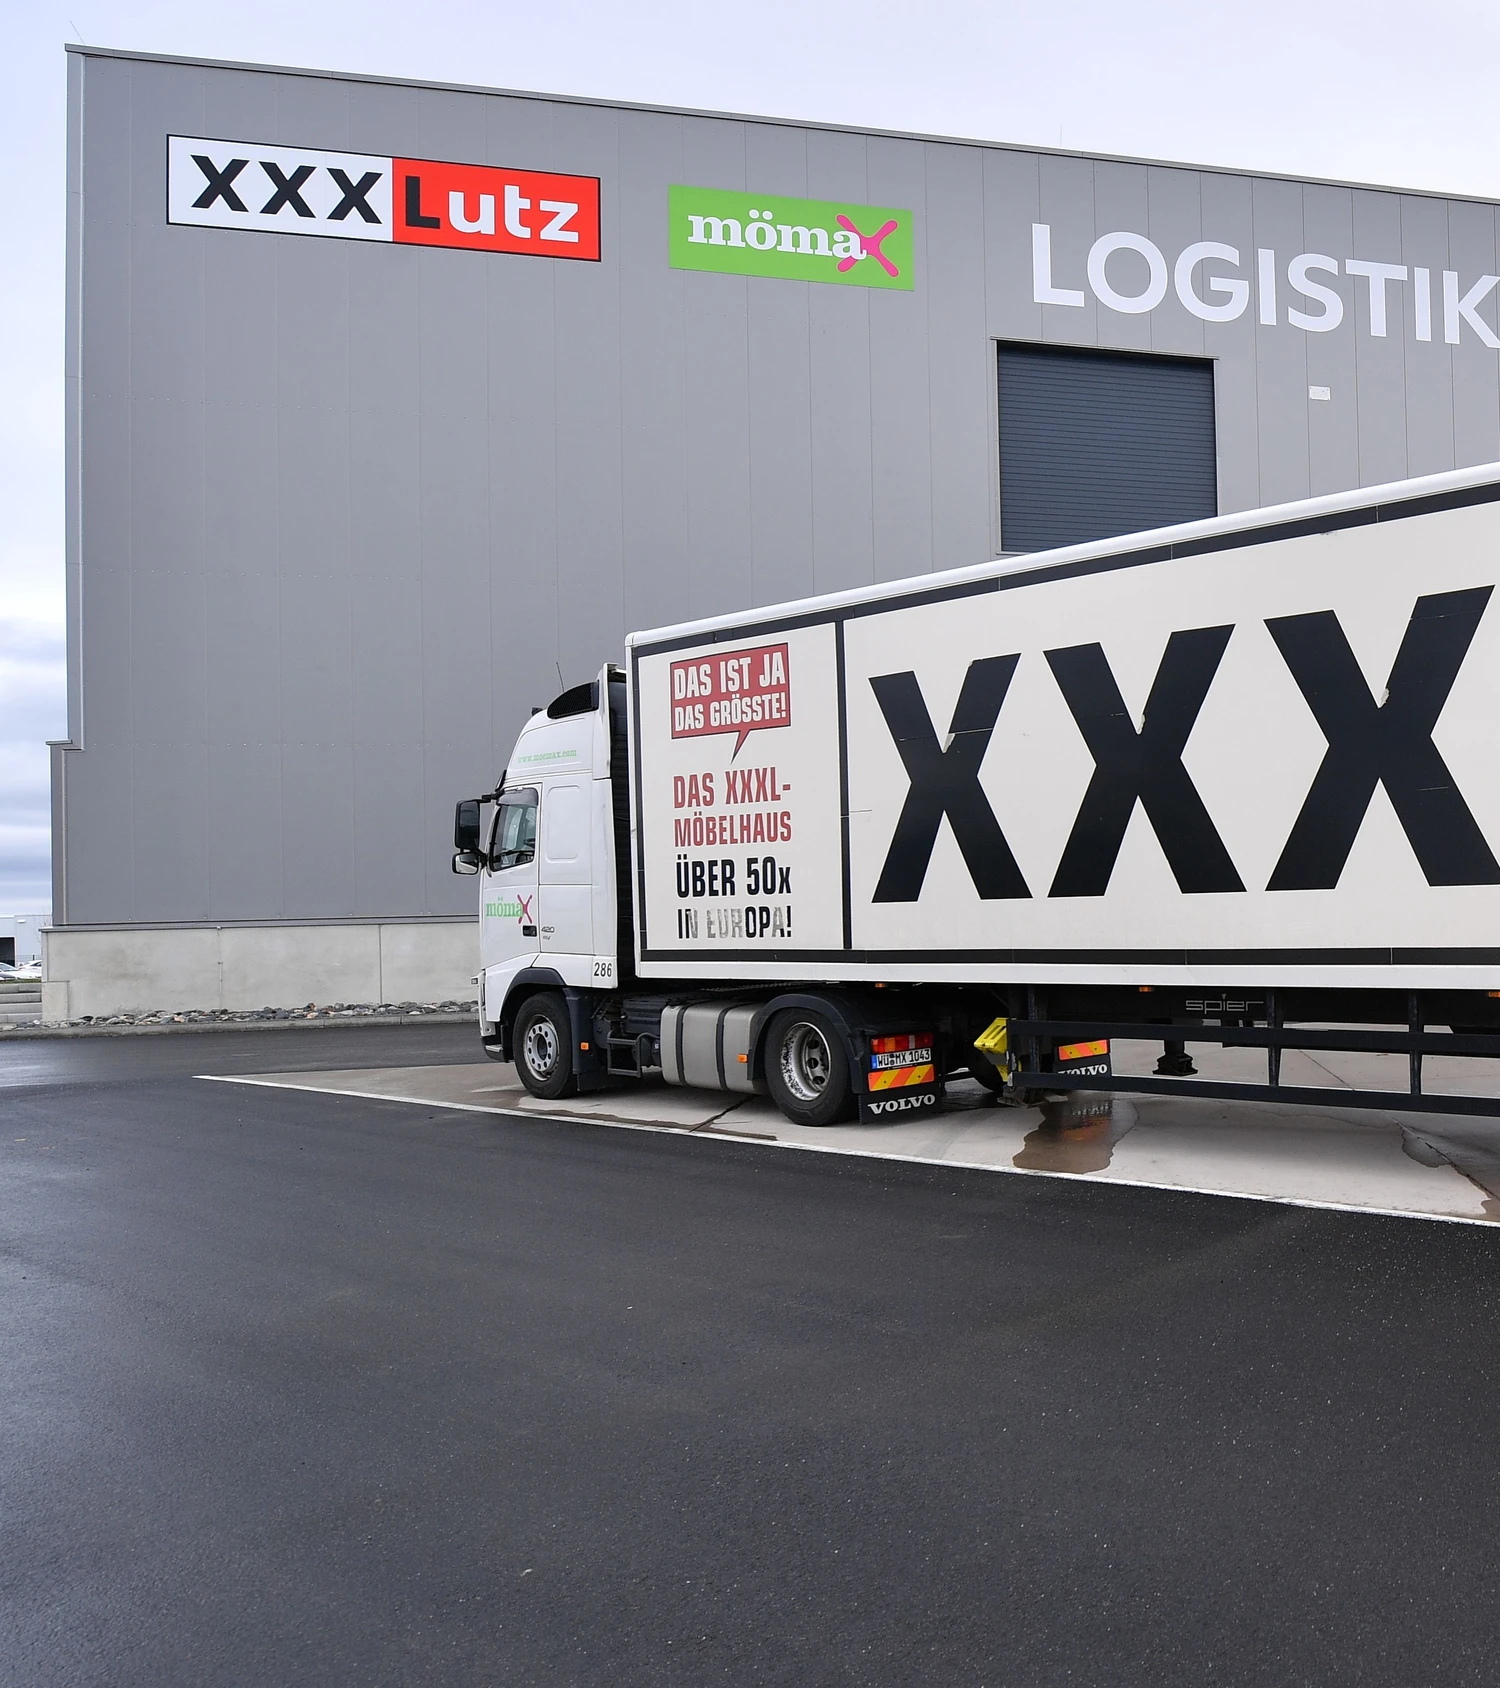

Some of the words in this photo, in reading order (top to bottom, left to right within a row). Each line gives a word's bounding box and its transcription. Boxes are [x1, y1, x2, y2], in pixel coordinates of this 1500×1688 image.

[190, 154, 580, 243] XXXLutz
[673, 663, 712, 700] DAS
[719, 656, 752, 693] IST
[759, 651, 786, 688] JA
[674, 703, 705, 732] DAS
[709, 691, 787, 727] GRÖSSTE!
[673, 772, 715, 809] DAS
[725, 766, 791, 805] XXXL-
[674, 811, 792, 847] MÖBELHAUS
[676, 853, 736, 898] ÜBER
[746, 856, 792, 896] 50x
[677, 907, 698, 939] IN
[706, 905, 792, 938] EUROPA!
[593, 962, 612, 977] 286
[1185, 993, 1264, 1015] spier
[908, 1048, 931, 1063] 1043
[867, 1094, 936, 1115] VOLVO
